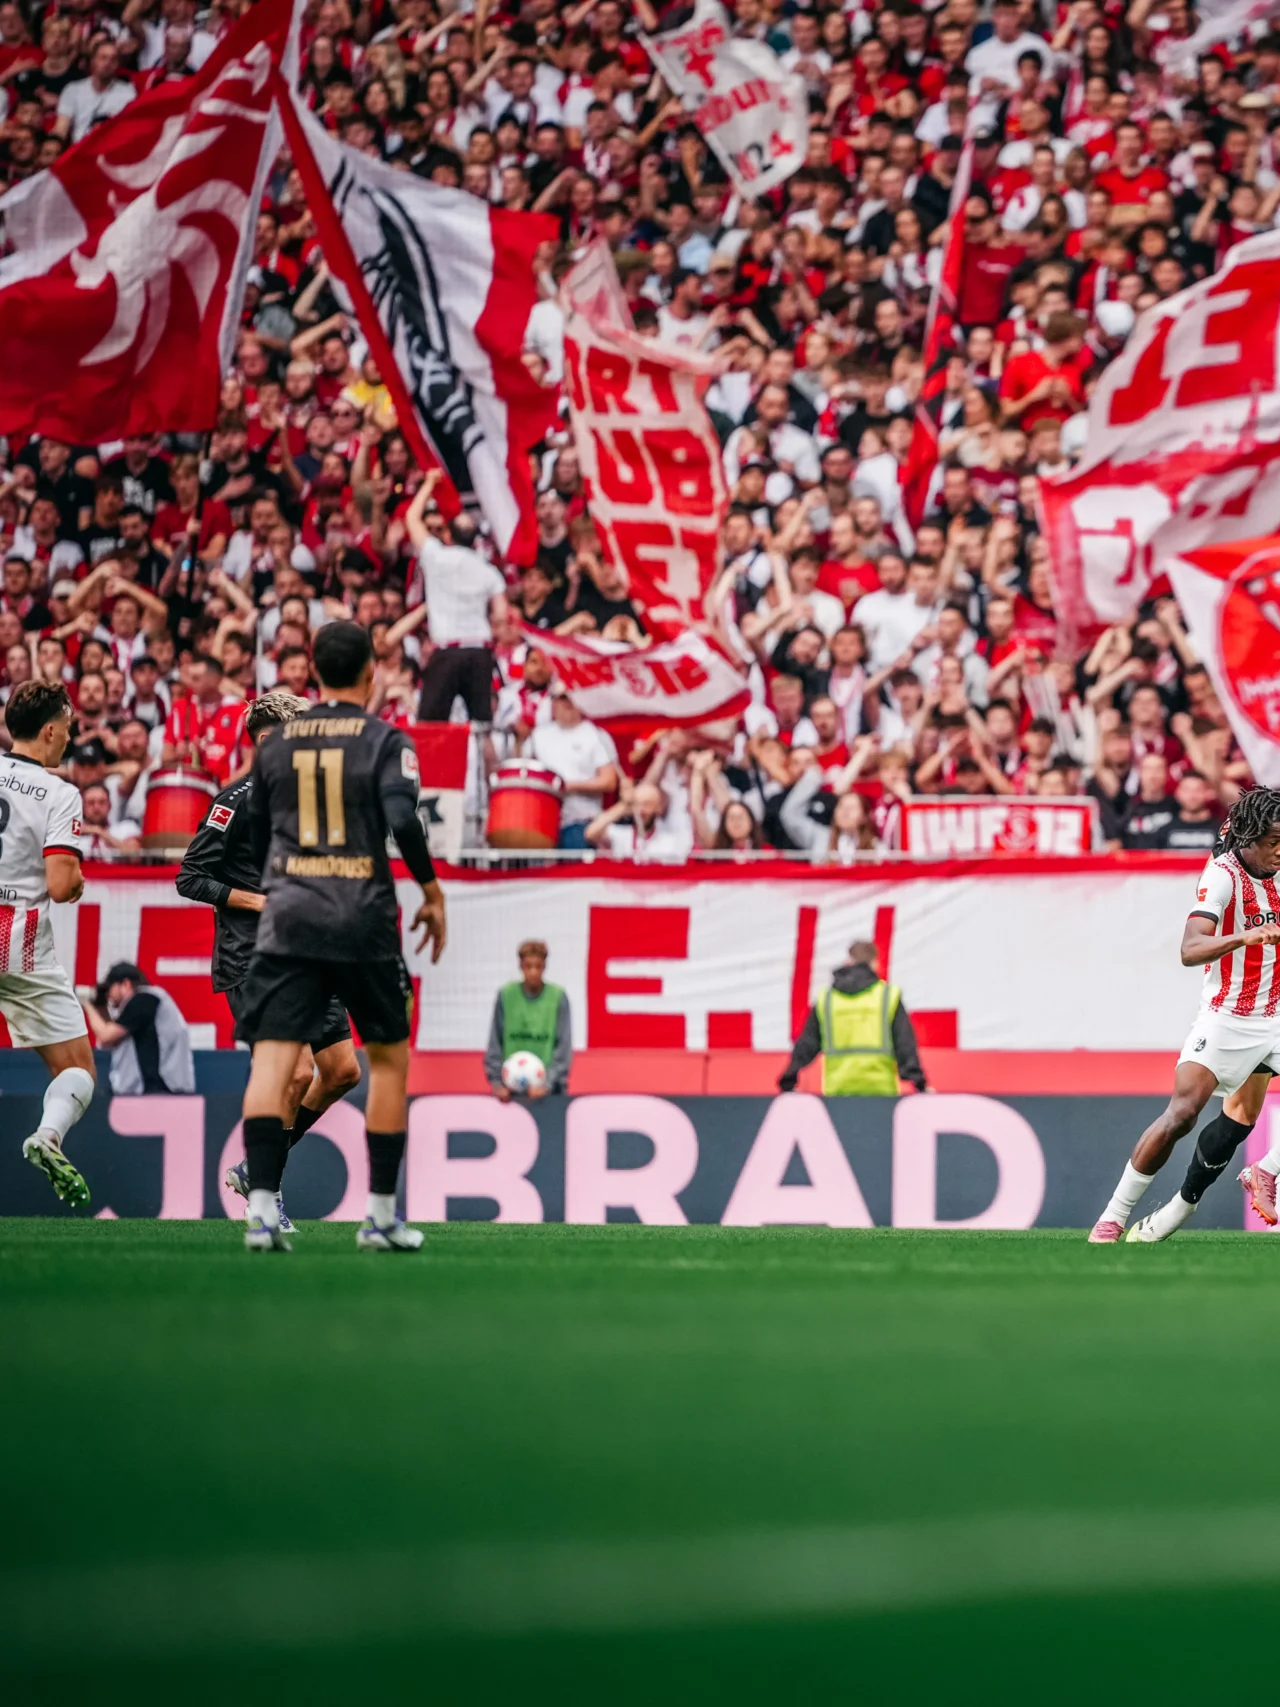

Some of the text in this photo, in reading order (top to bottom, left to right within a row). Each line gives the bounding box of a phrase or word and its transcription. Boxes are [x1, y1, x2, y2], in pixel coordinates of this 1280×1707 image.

[594, 426, 714, 516] UB
[283, 717, 367, 740] STUTTGART
[292, 748, 346, 847] 11
[94, 1092, 1046, 1230] JOBRAD
